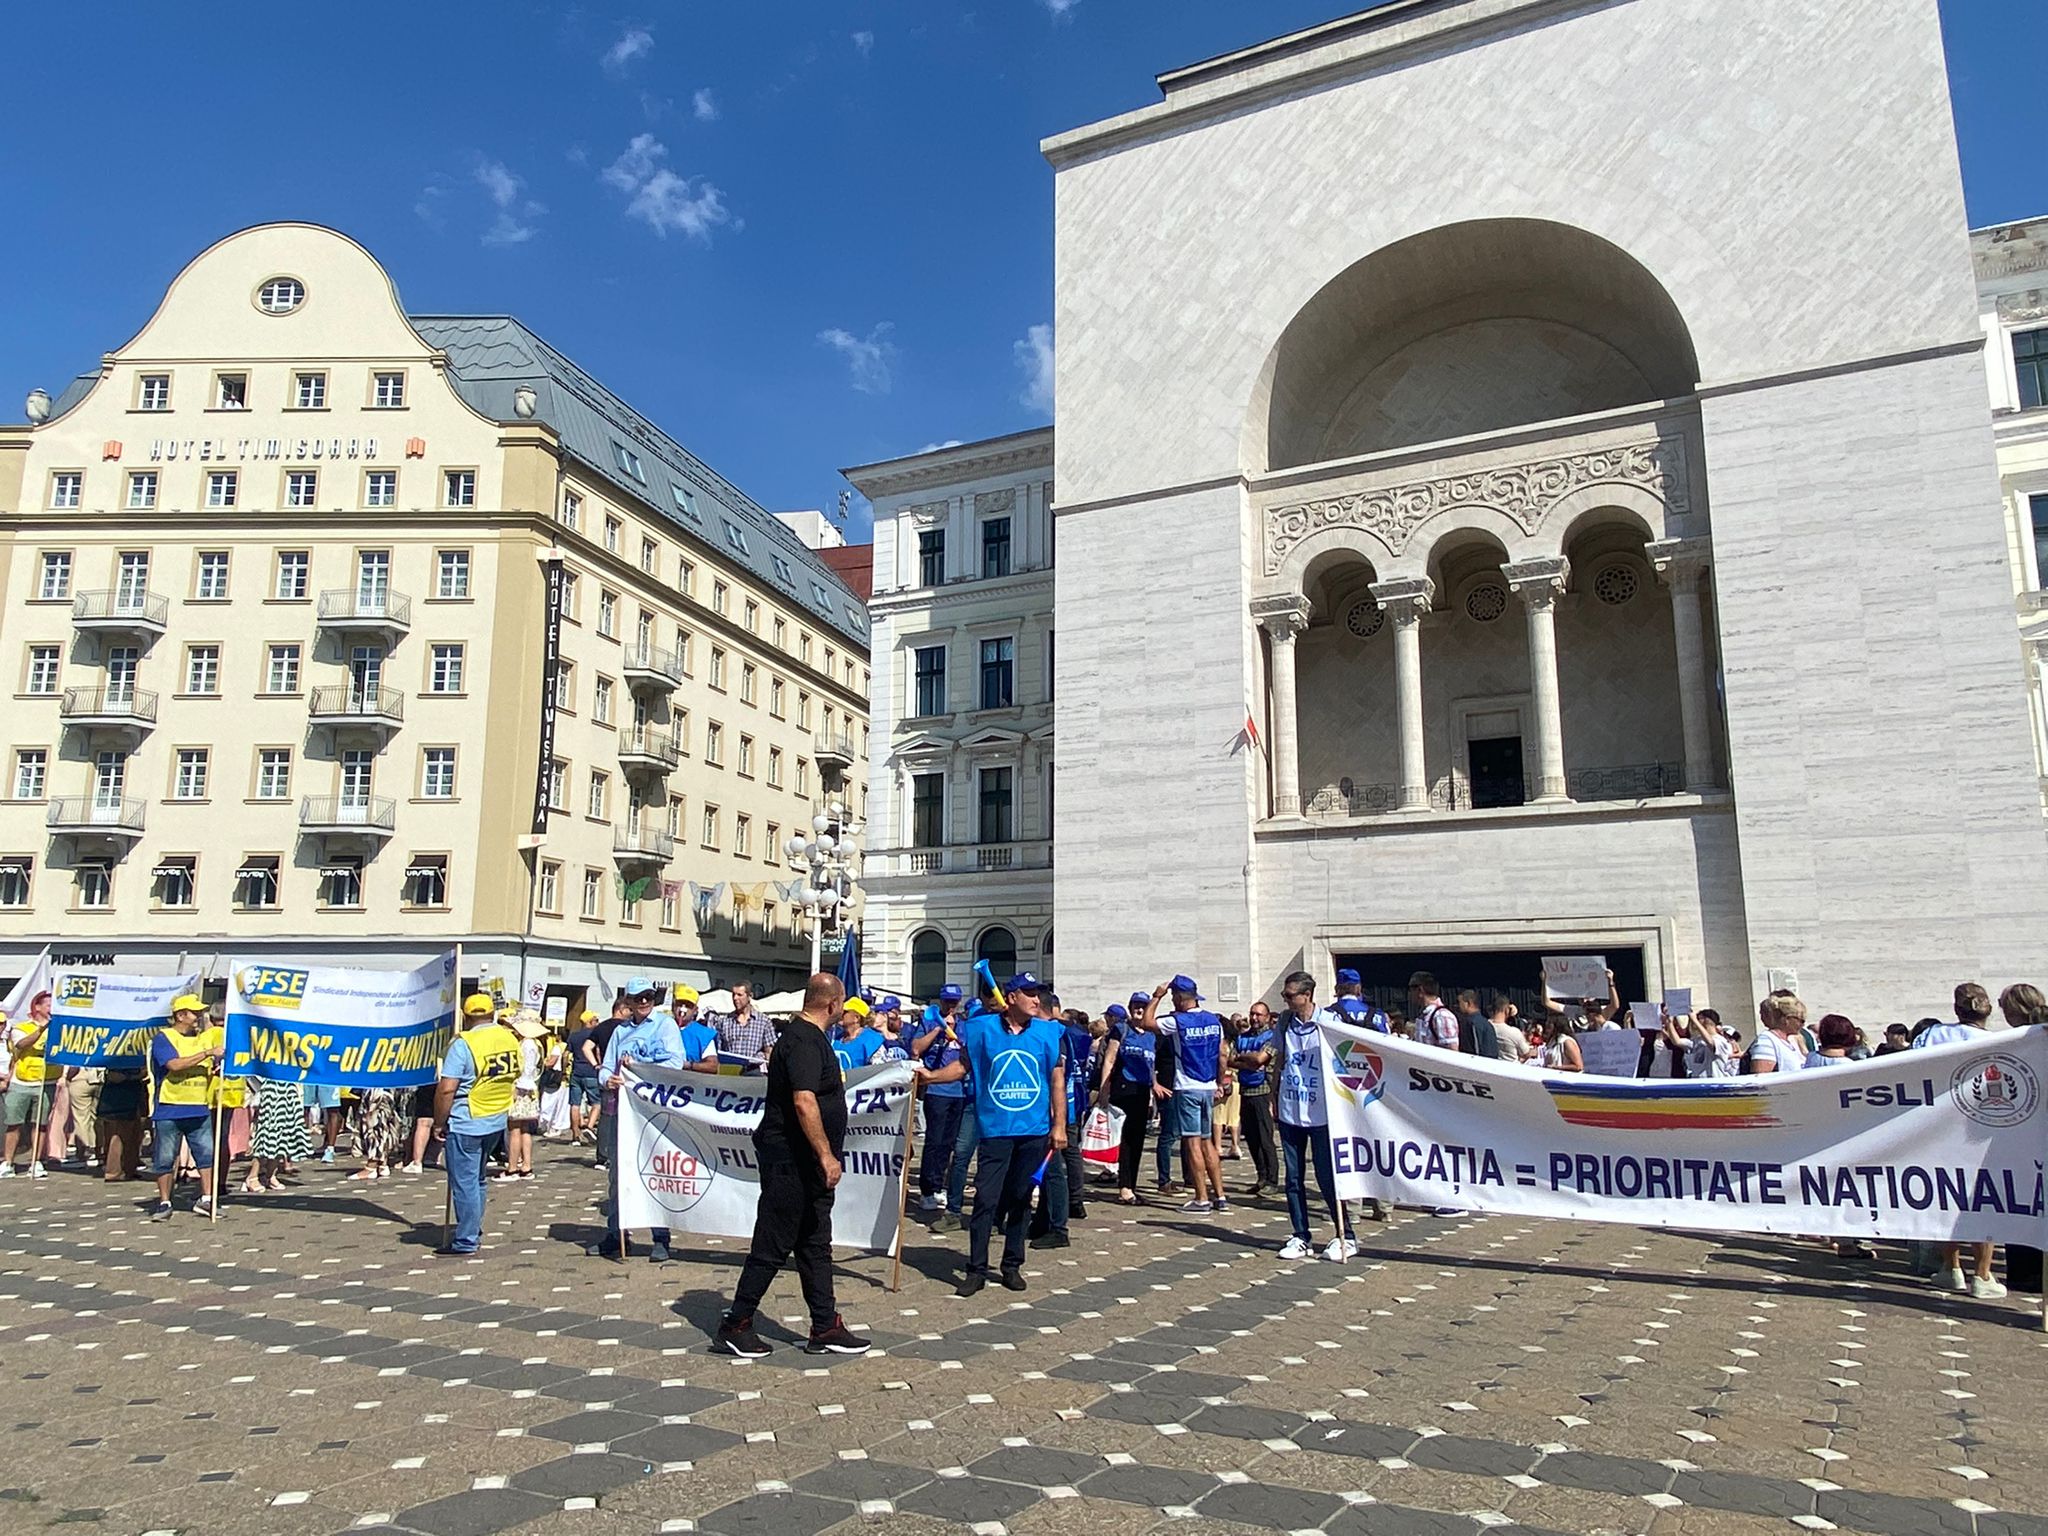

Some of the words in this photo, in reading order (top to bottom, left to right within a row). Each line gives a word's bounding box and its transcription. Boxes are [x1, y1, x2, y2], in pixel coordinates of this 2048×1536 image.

[150, 439, 226, 461] HOTEL
[547, 570, 559, 660] HOTEL
[51, 954, 116, 966] FIRSTBANK
[69, 977, 97, 996] FSE
[257, 969, 307, 994] FSE
[487, 1051, 519, 1076] FSE
[1286, 1074, 1319, 1088] SOLE
[1408, 1067, 1495, 1101] SOLE
[632, 1081, 695, 1108] CNS
[705, 1087, 766, 1114] "Car
[850, 1086, 905, 1114] FA"
[999, 1091, 1031, 1100] CARTEL
[1839, 1079, 1935, 1109] FSLI
[844, 1124, 906, 1137] RITORIALA
[653, 1150, 698, 1177] alfa
[648, 1176, 700, 1196] CARTEL
[1332, 1136, 1505, 1194] EDUCAȚIA
[1515, 1163, 1536, 1186] =
[1550, 1152, 1786, 1205] PRIORITATE
[1799, 1159, 2044, 1222] NAȚIONALĂ
